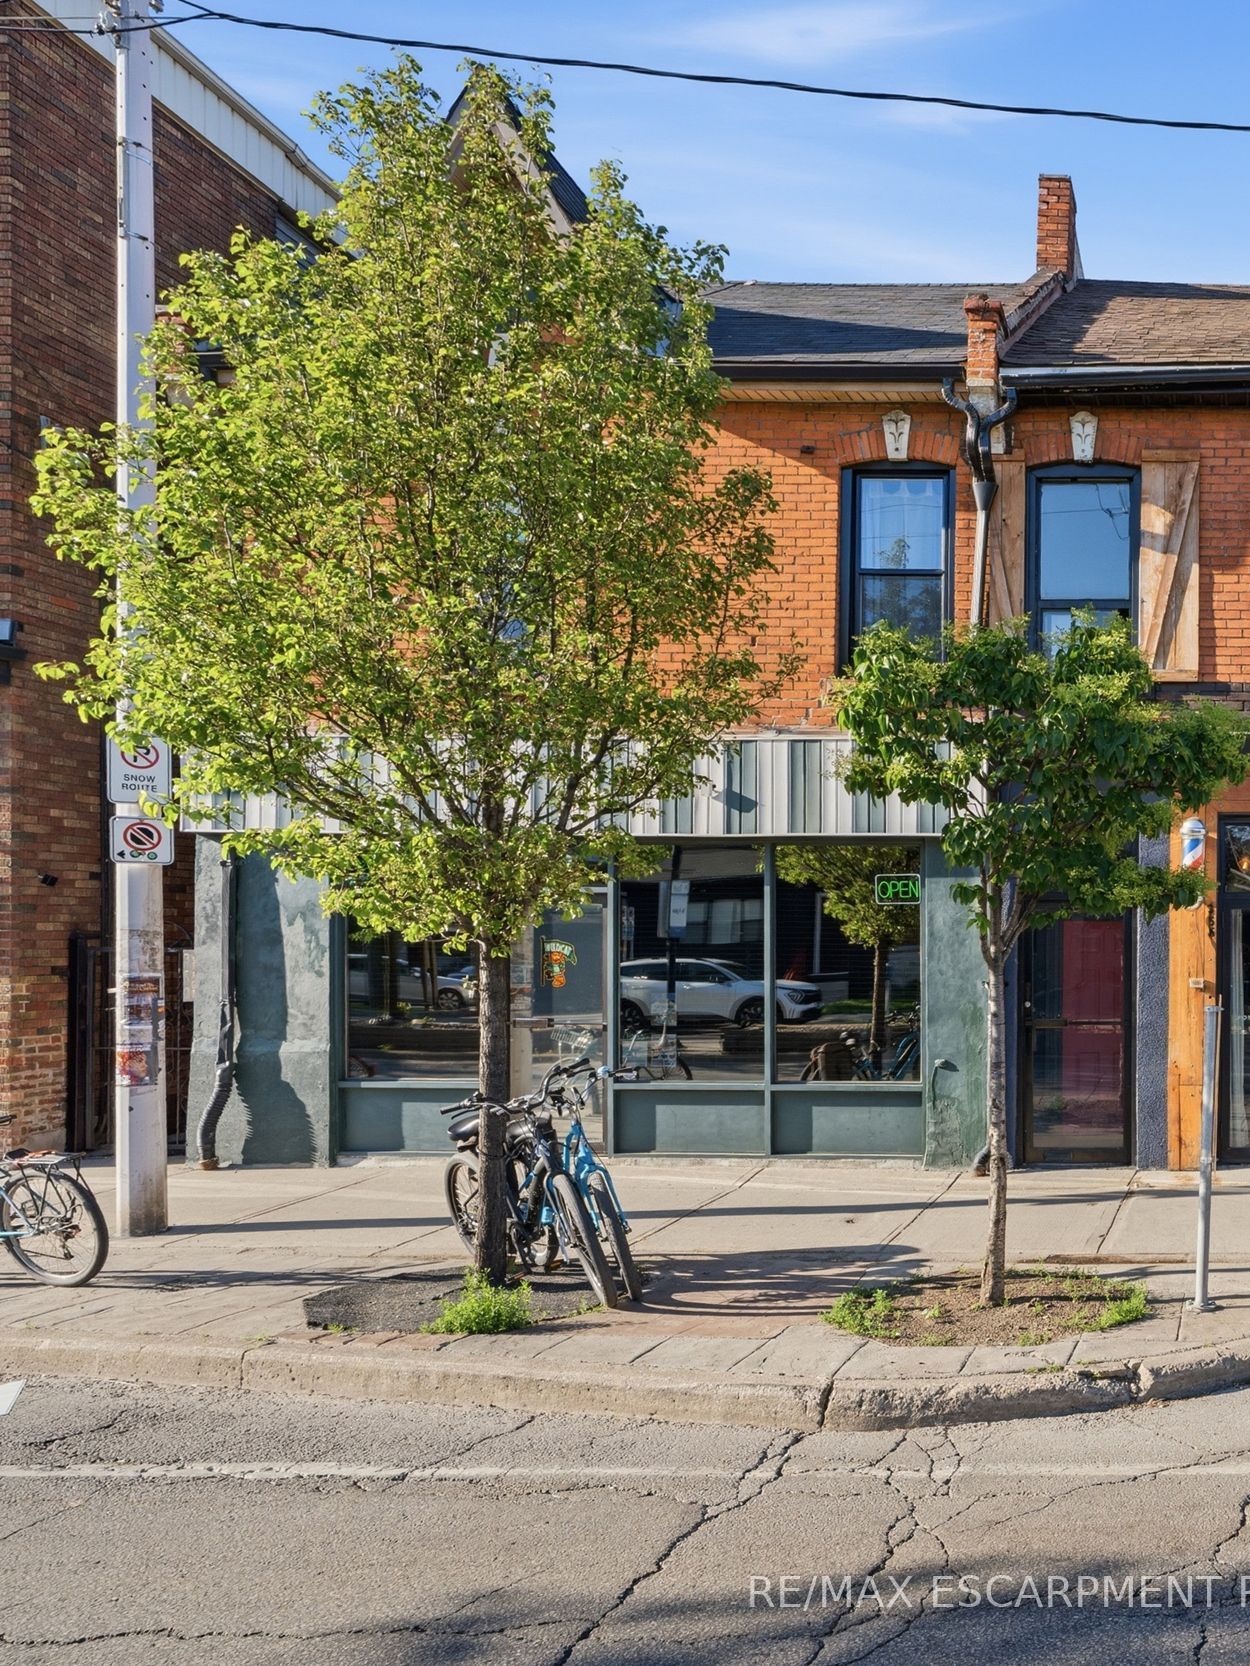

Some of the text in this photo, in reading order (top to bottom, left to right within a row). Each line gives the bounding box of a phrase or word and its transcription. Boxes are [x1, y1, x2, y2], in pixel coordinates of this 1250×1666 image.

[123, 773, 156, 783] SNOW
[121, 783, 158, 793] ROUTE
[878, 880, 919, 899] OPEN
